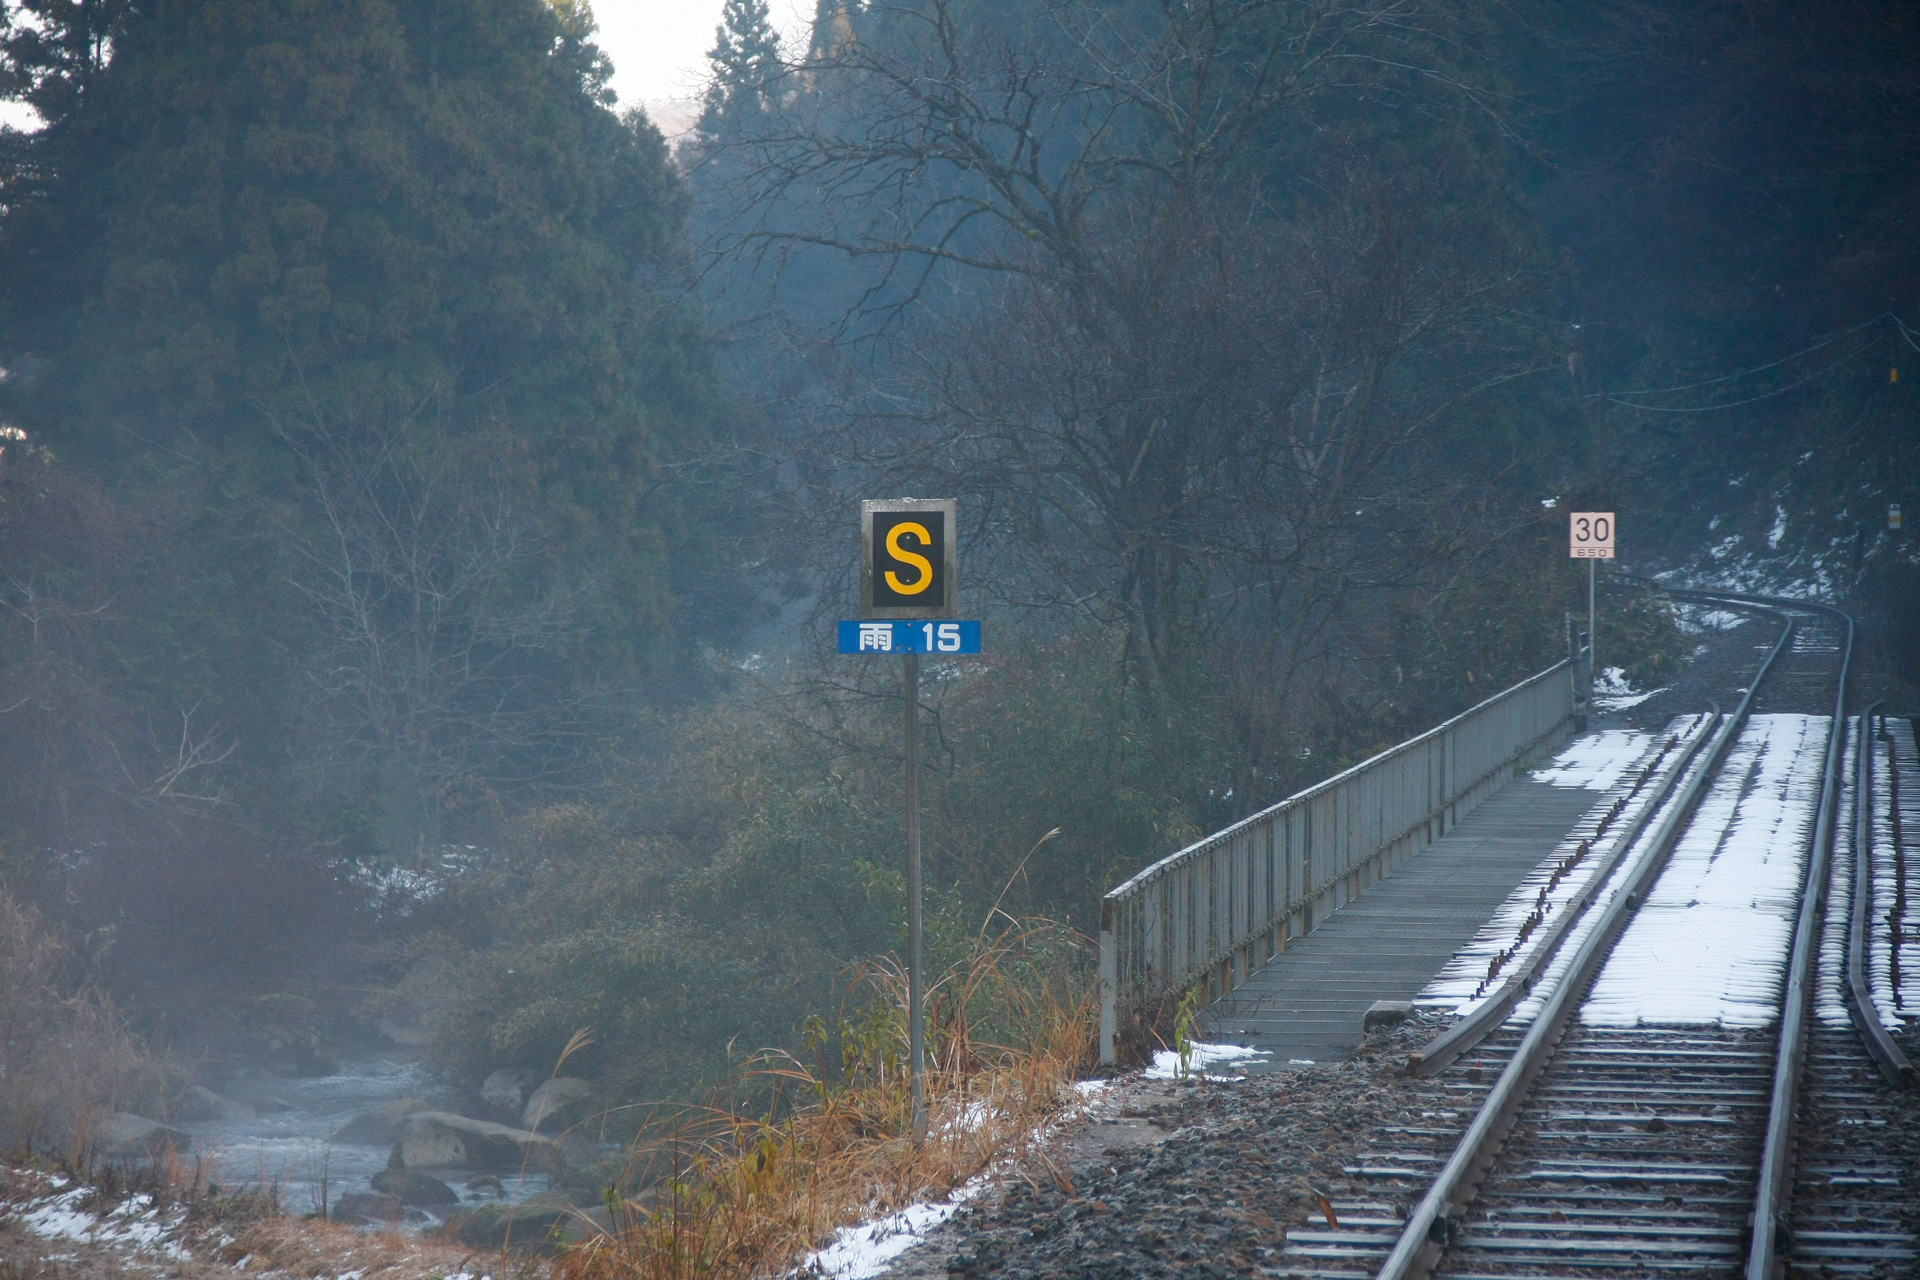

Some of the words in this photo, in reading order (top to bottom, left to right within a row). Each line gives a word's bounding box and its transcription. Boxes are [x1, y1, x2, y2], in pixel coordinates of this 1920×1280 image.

[1576, 517, 1609, 542] 30
[884, 522, 933, 596] S
[1577, 548, 1607, 557] 650
[859, 623, 893, 651] 雨
[922, 622, 961, 652] 15
